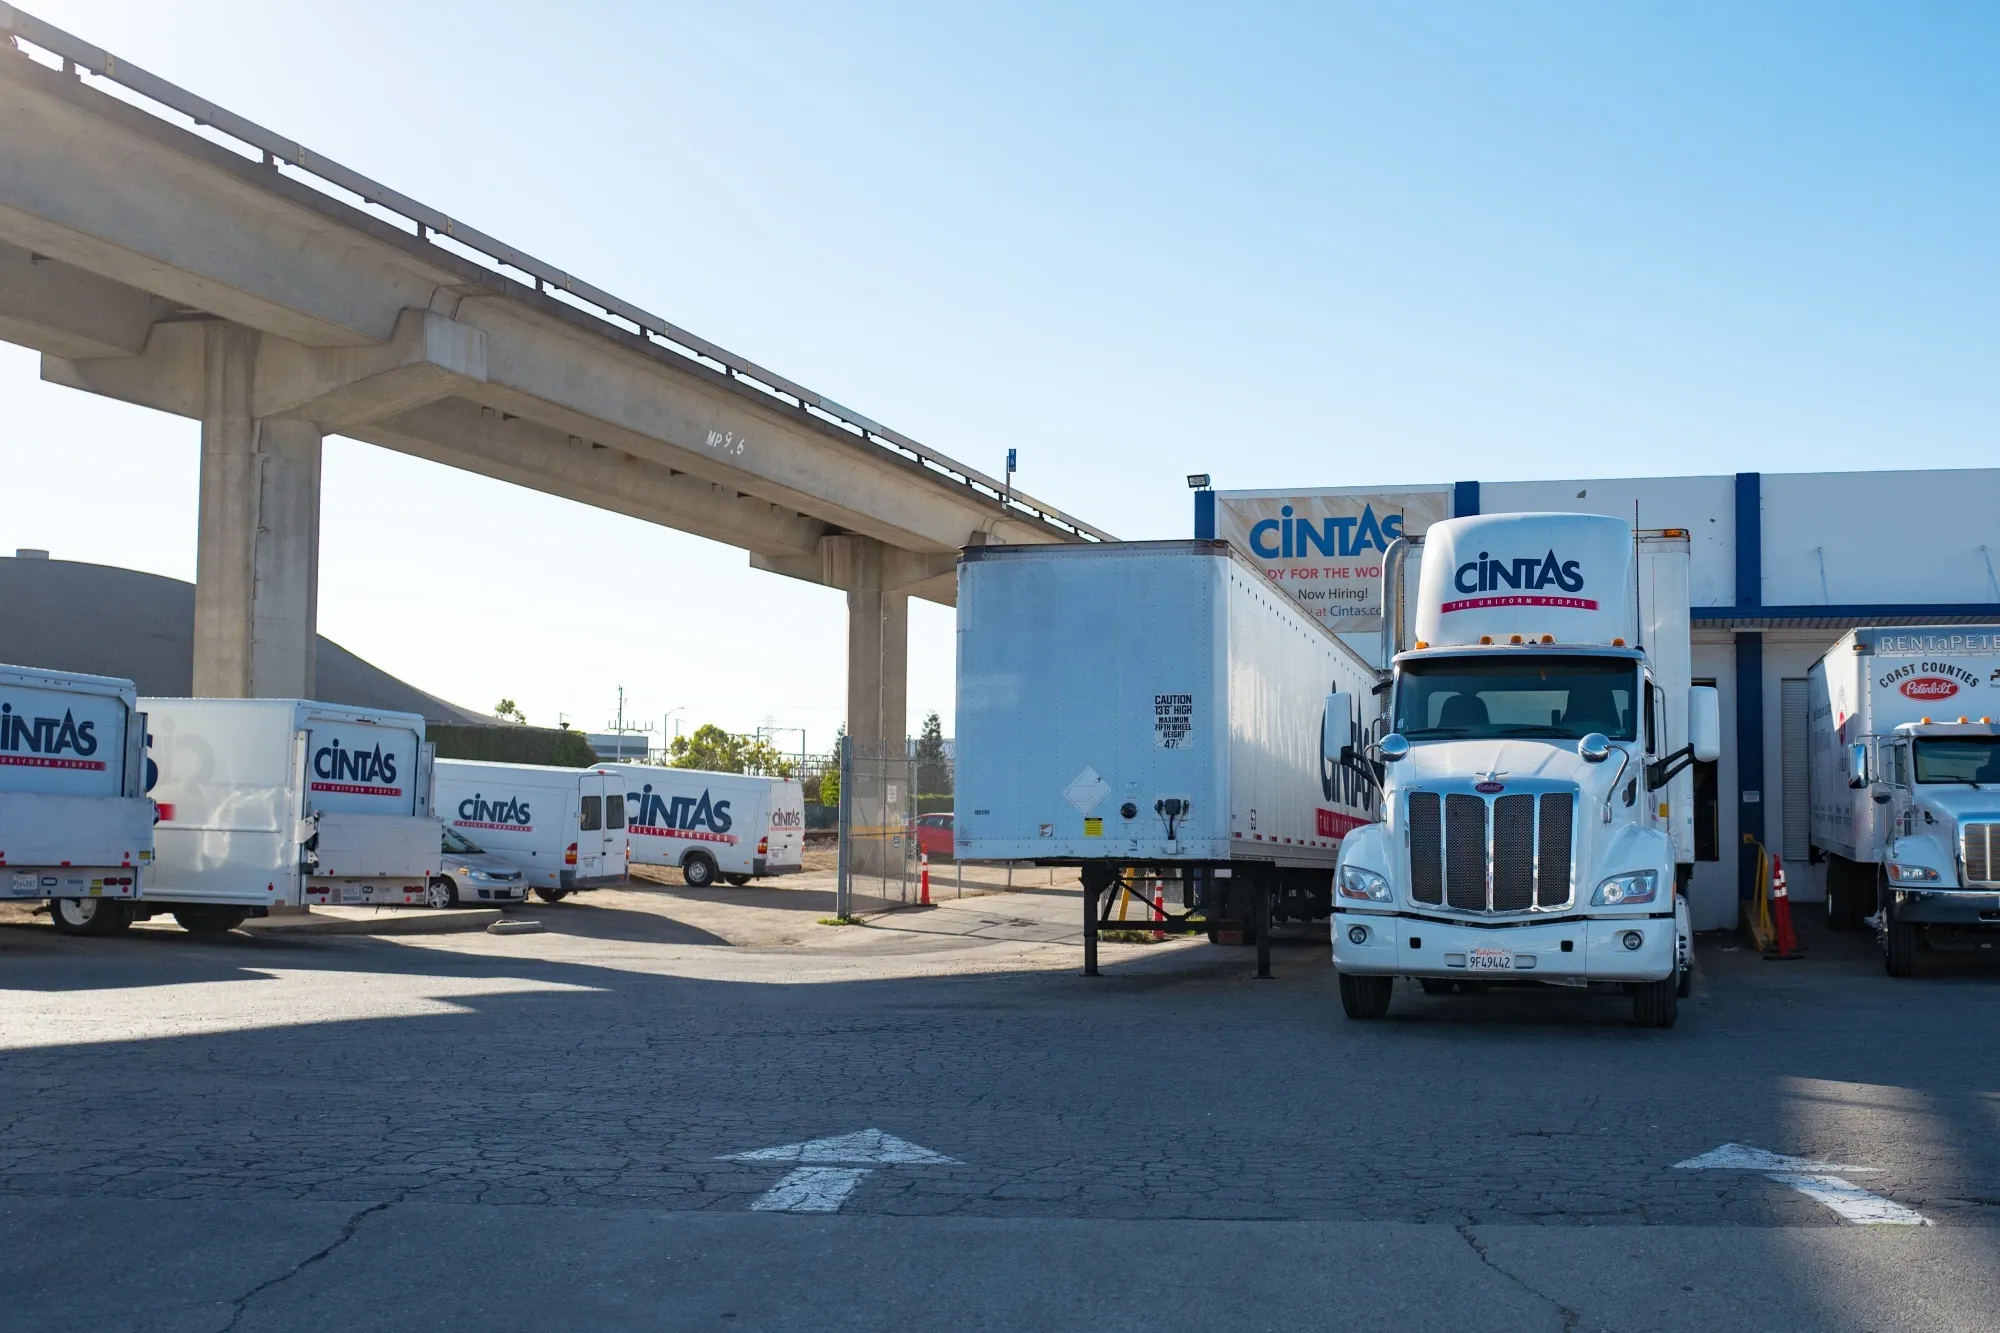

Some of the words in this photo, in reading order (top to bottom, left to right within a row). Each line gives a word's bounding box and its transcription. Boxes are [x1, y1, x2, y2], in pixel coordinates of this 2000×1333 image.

[1291, 568, 1319, 580] FOR
[1323, 567, 1350, 579] THE
[1355, 567, 1382, 578] WO
[1298, 589, 1325, 600] Now
[1329, 588, 1368, 601] Hiring!
[1452, 601, 1470, 609] THE
[1479, 598, 1532, 606] UNIFORM
[1542, 598, 1586, 607] PEOPLE
[1316, 608, 1327, 617] at
[1879, 664, 1916, 688] COAST
[1922, 662, 1979, 688] COUNTIES
[1906, 681, 1956, 696] Peterbilt
[1154, 695, 1192, 705] CAUTION
[1174, 705, 1192, 715] HIGH
[1158, 716, 1189, 724] MAXIMUM
[1155, 723, 1171, 731] FIFTH
[1172, 723, 1192, 731] WHEEL
[57, 760, 96, 769] PEOPLE
[331, 784, 364, 793] UNIFORM
[674, 830, 728, 842] SERVICES
[1469, 956, 1511, 969] 9F49442
